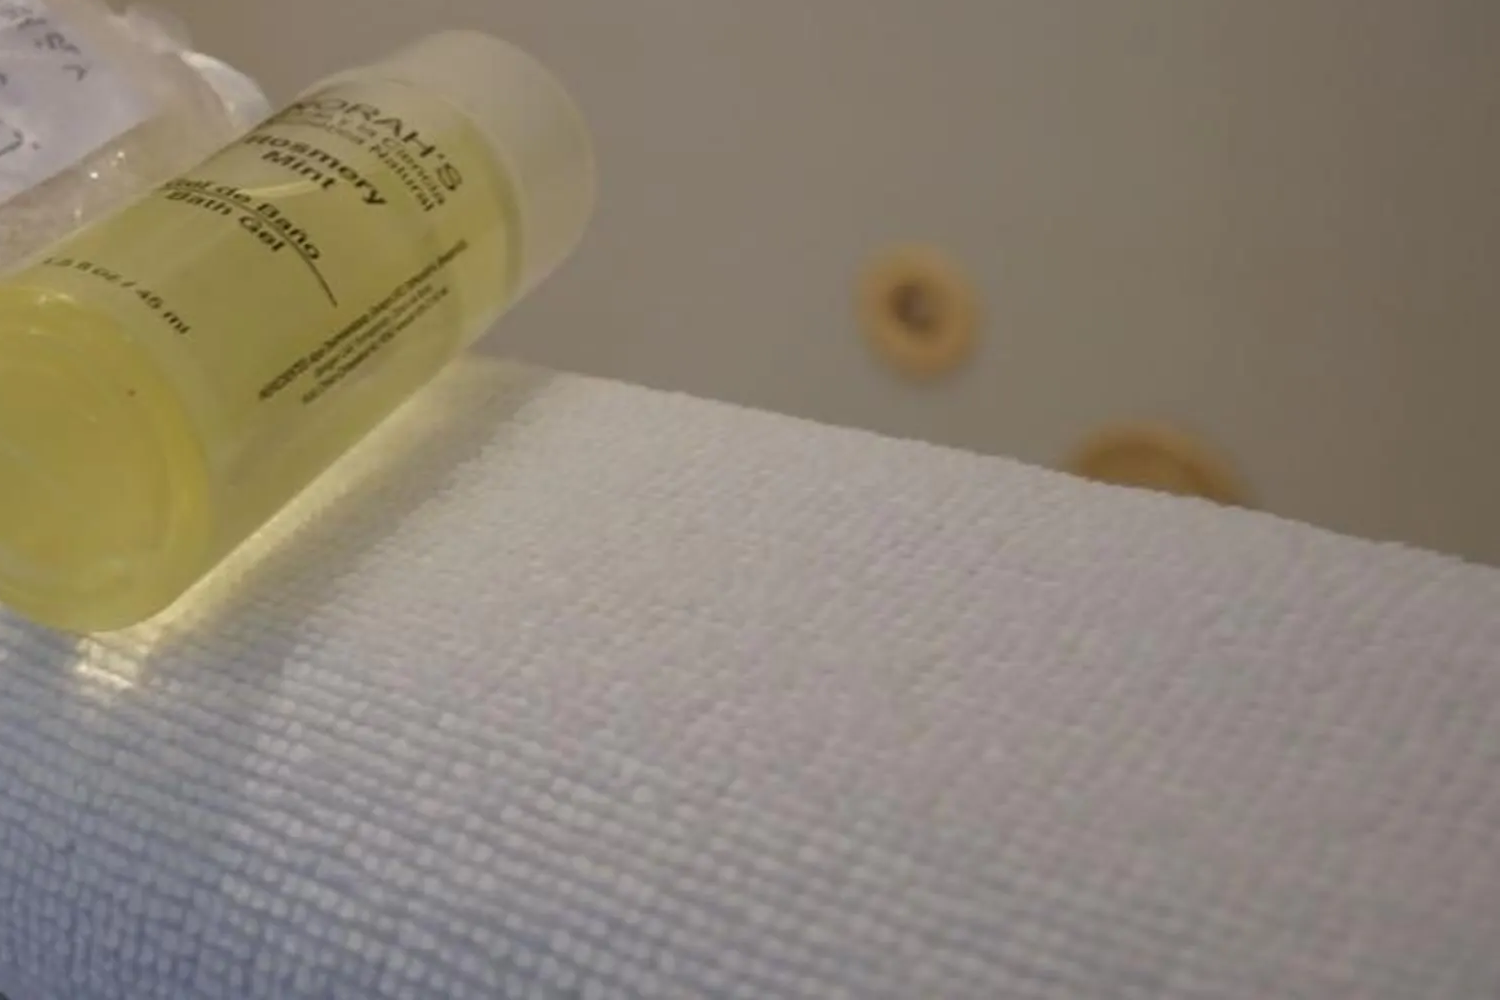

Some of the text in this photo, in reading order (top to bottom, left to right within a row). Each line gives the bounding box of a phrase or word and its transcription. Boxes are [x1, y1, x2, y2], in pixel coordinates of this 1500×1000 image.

[261, 149, 337, 190] Mint
[369, 142, 436, 212] Natural
[164, 190, 287, 252] Bath Gel
[215, 185, 252, 203] de
[256, 202, 321, 260] Baño
[162, 311, 192, 335] ml
